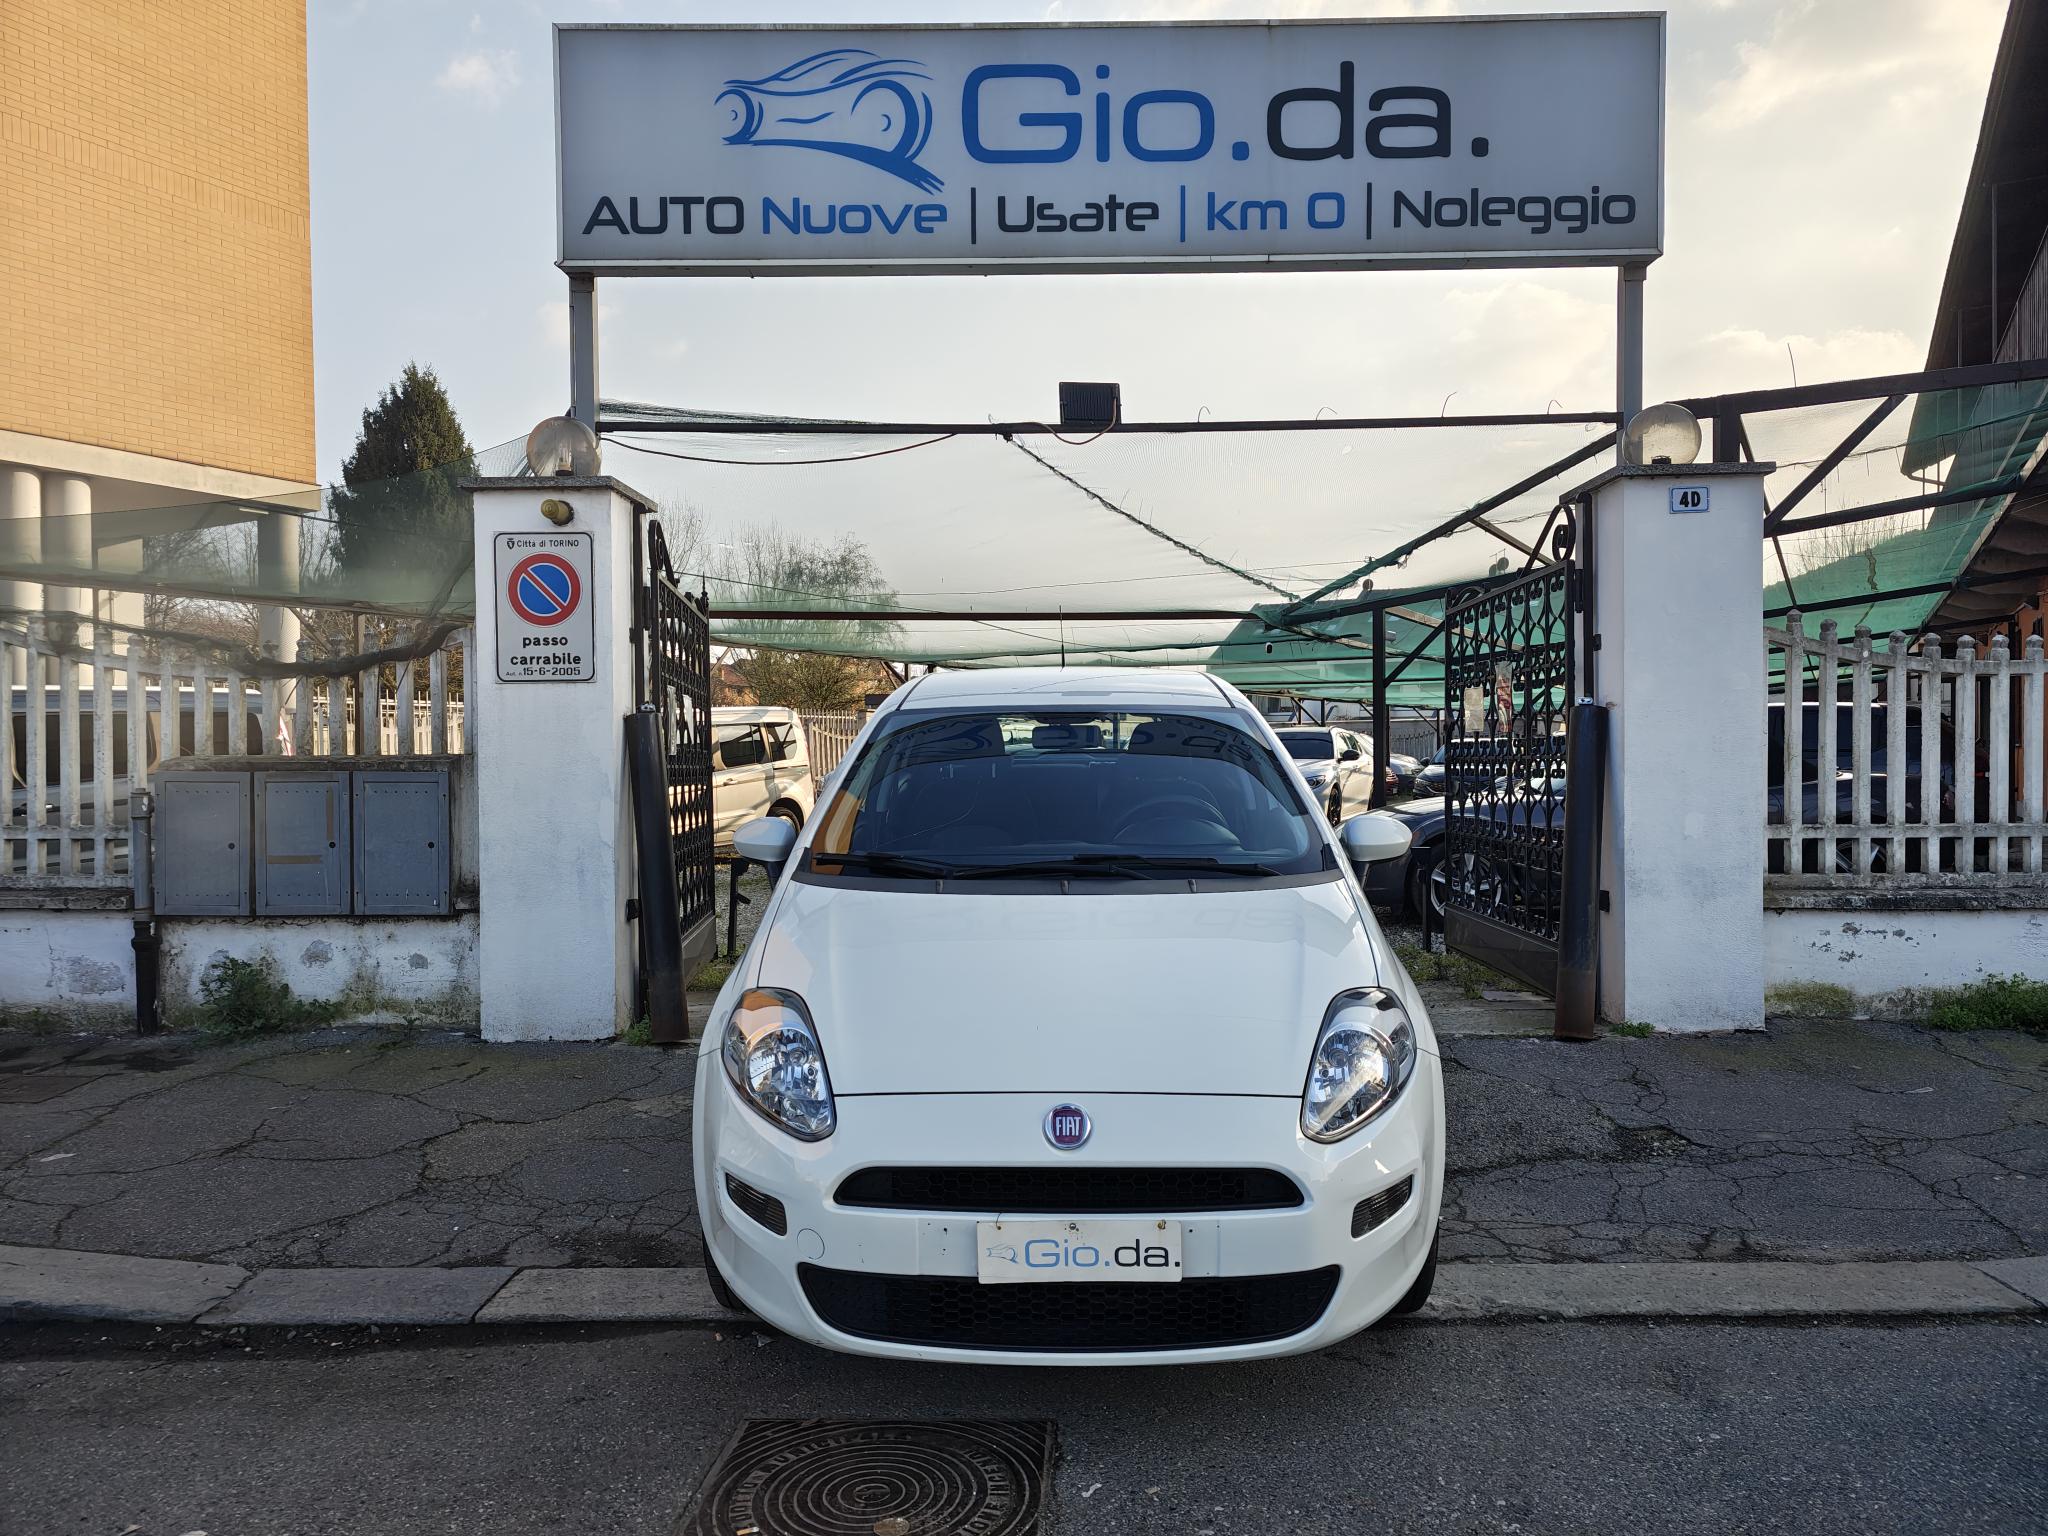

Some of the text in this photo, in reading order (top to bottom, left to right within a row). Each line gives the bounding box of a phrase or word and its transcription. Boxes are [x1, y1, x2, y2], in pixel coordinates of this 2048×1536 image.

[962, 61, 1489, 164] Gio.da.
[582, 196, 745, 235] AUTO
[762, 197, 948, 235] Nuove
[996, 194, 1160, 234] Usate
[1207, 191, 1288, 231] km
[1393, 185, 1636, 235] Noleggio
[1679, 491, 1701, 508] 4D
[539, 539, 546, 547] di
[549, 539, 580, 548] TORINO
[522, 636, 568, 649] passo
[510, 653, 582, 666] carrabile
[523, 667, 581, 676] 15-6-2005
[1055, 1116, 1081, 1136] FIAT
[1024, 1238, 1181, 1268] Gio.da.
